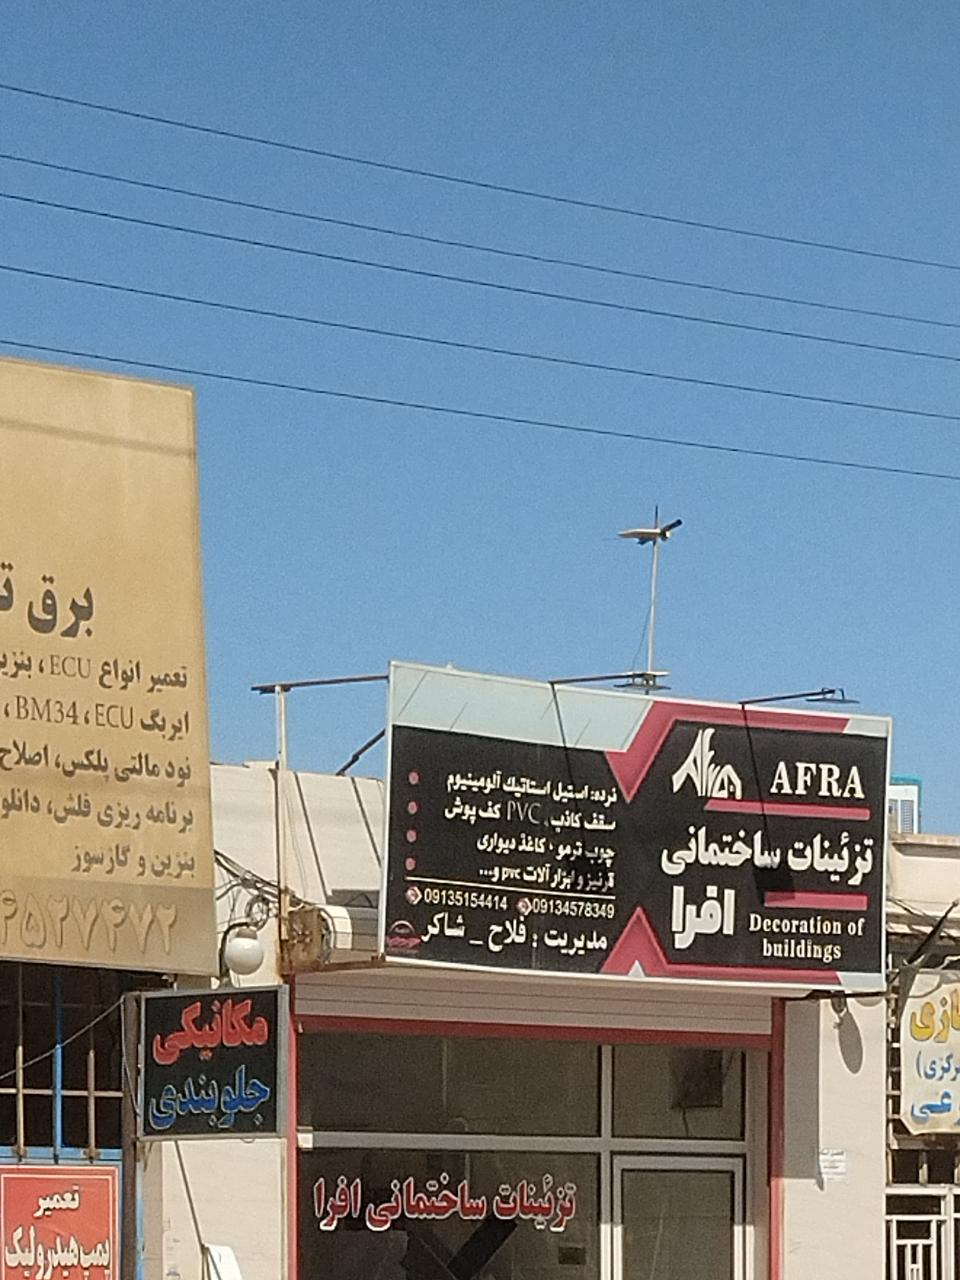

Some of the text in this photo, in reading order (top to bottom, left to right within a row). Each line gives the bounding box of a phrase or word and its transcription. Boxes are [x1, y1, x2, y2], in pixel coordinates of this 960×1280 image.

[27, 574, 95, 638] برق
[98, 659, 141, 690] انواع
[146, 665, 188, 693] تعمیر
[114, 754, 160, 783] مالتی
[165, 756, 192, 787] نود
[447, 770, 502, 794] آلومینیوم
[769, 761, 865, 799] AFRA
[553, 781, 588, 802] استیل
[96, 804, 141, 829] ریزی
[145, 801, 194, 832] برنامه
[444, 797, 478, 824] پوش
[479, 801, 502, 820] کف
[506, 800, 542, 824] PVC
[583, 812, 616, 831] سقف
[476, 832, 517, 854] دیواری
[518, 834, 546, 853] کاغذ
[585, 846, 615, 867] چوب
[661, 825, 873, 885] تزئینات ساختمانی
[137, 857, 148, 877] و
[150, 852, 195, 879] بنزین
[424, 888, 615, 919] 09135154414 09134578349
[671, 885, 735, 949] افرا
[420, 911, 465, 942] شاکر
[488, 915, 527, 951] فلاح
[749, 914, 865, 936] Decoration of
[763, 938, 841, 962] buildings
[153, 999, 268, 1065] مکانیکی
[149, 1064, 270, 1130] جلوبندی
[33, 1184, 80, 1218] تعمیر
[313, 1172, 577, 1232] تزئینات ساختمانی افرا
